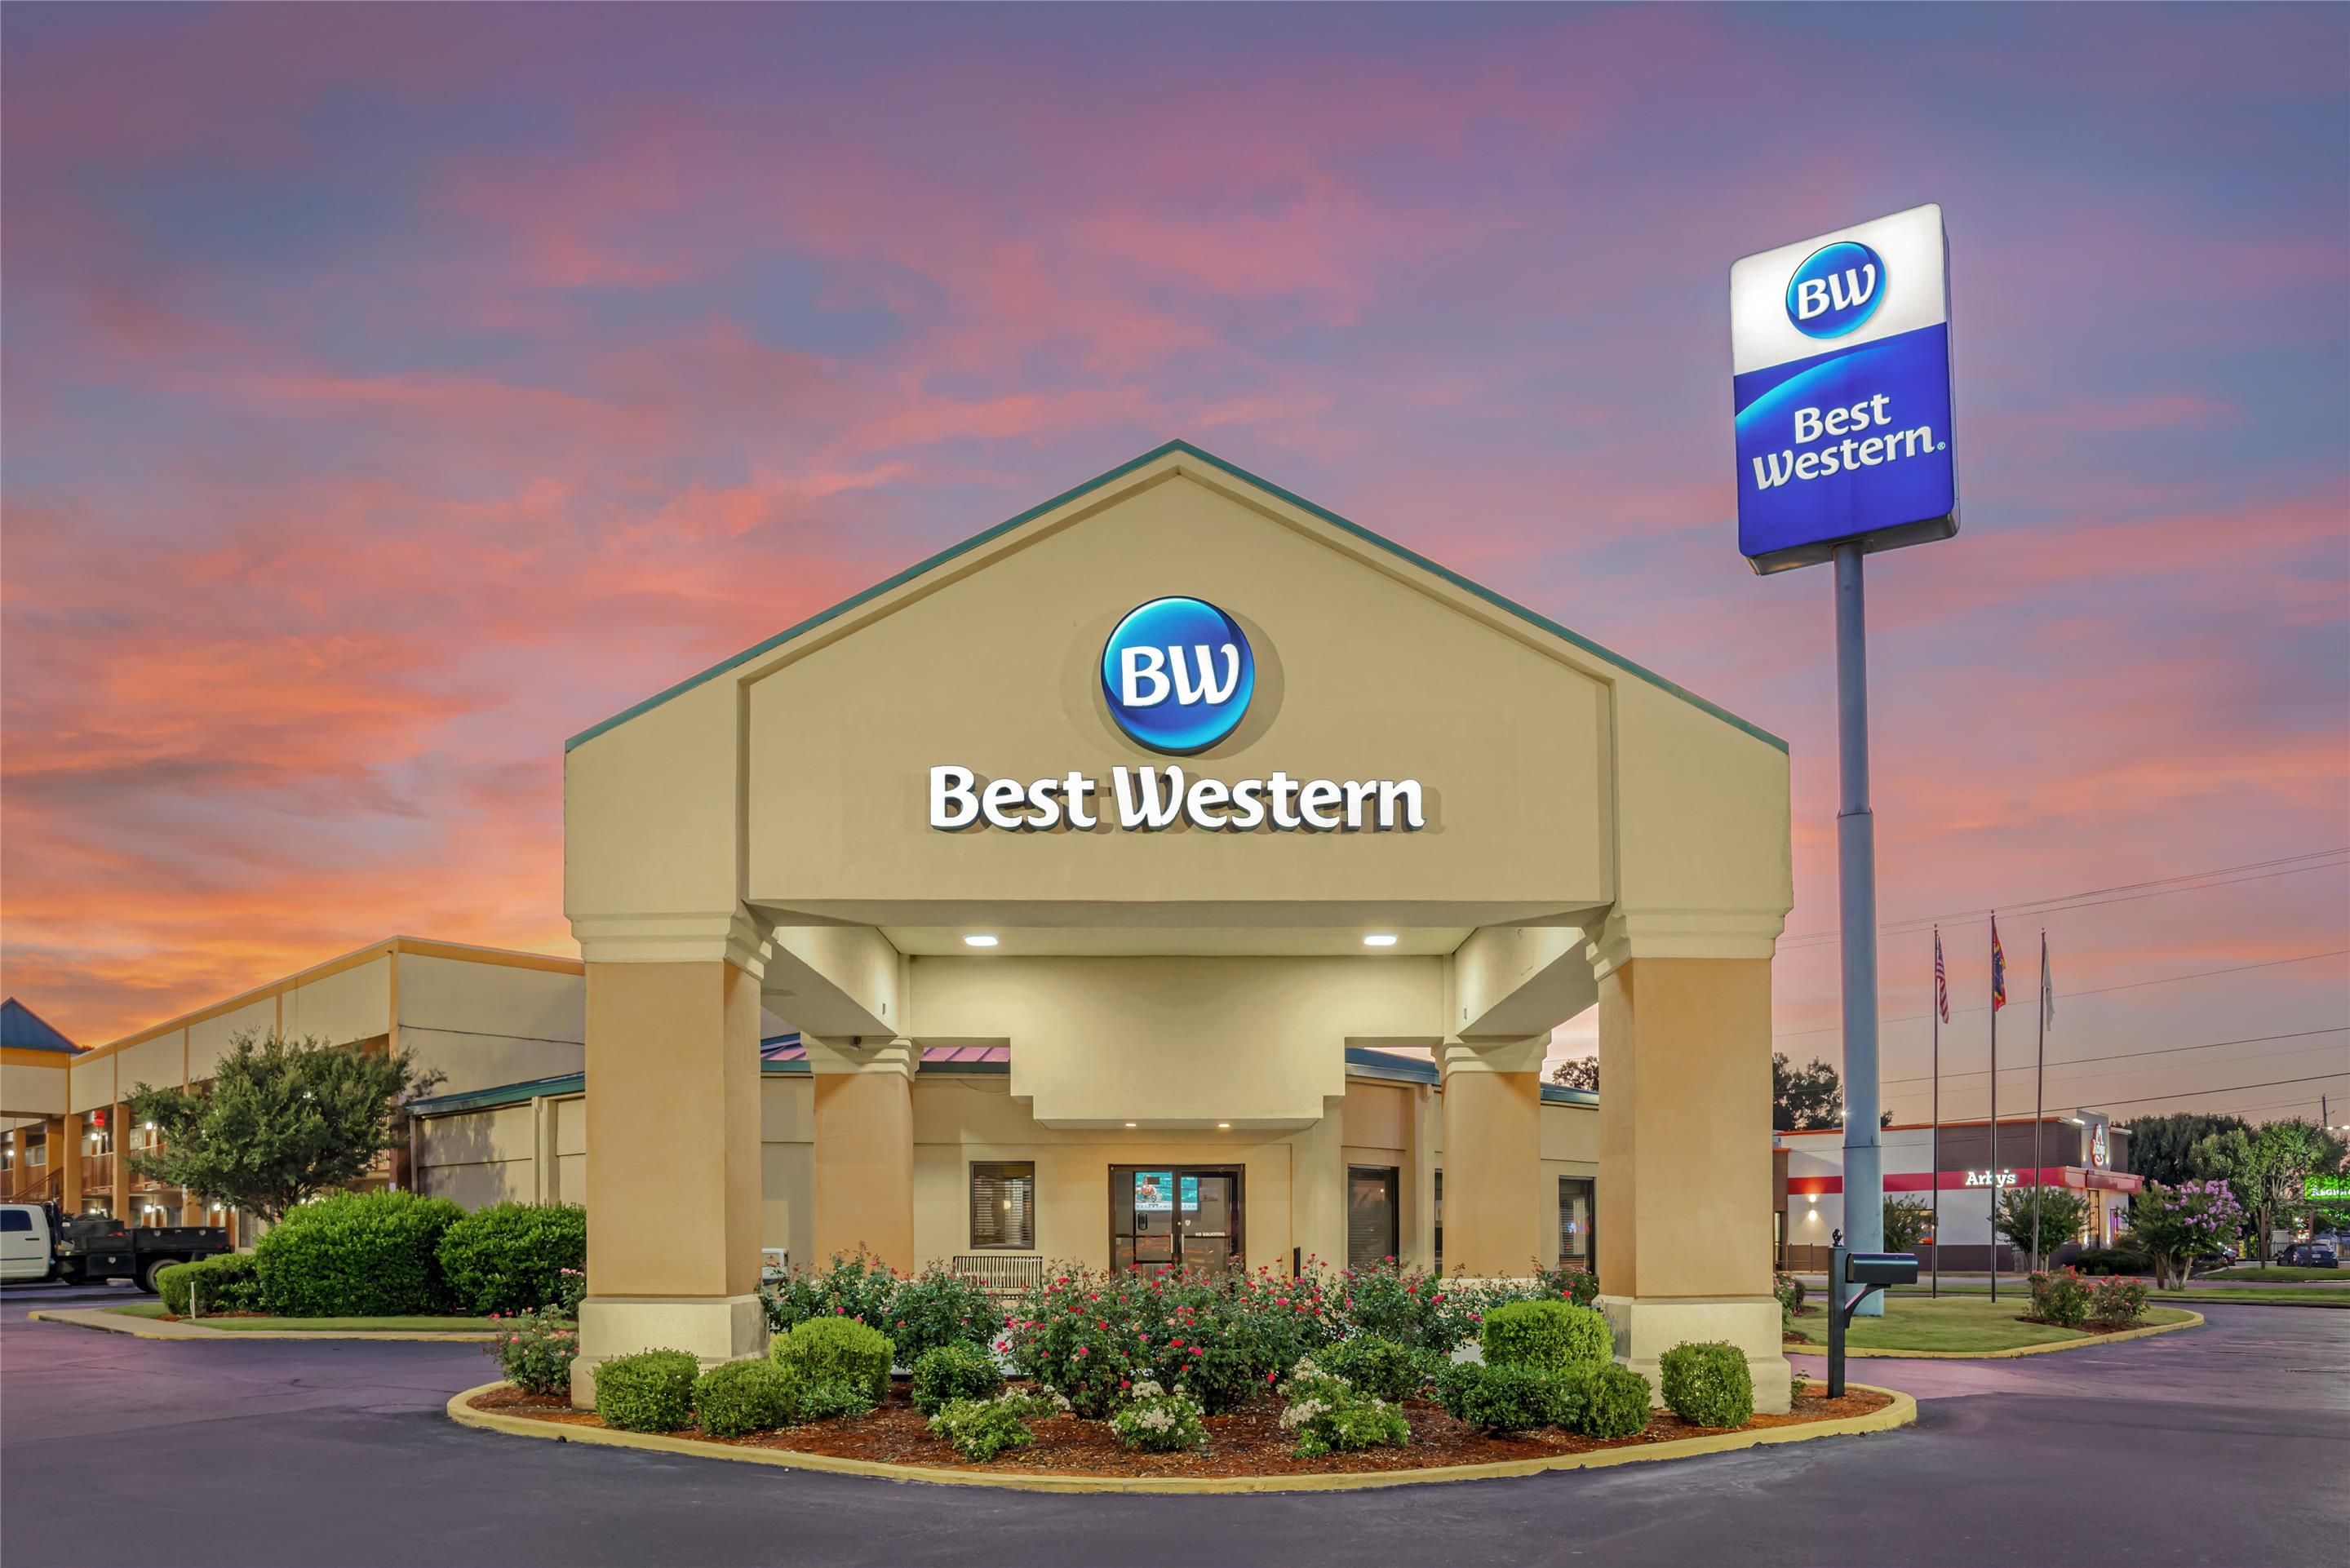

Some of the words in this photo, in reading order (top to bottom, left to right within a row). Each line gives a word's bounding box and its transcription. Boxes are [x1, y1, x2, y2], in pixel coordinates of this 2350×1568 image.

[1798, 263, 1876, 321] BW
[1794, 393, 1891, 445] Best
[1120, 643, 1239, 707] BW
[929, 764, 1097, 829] Best
[1111, 764, 1426, 829] Western
[1965, 1169, 2016, 1189] Arby's
